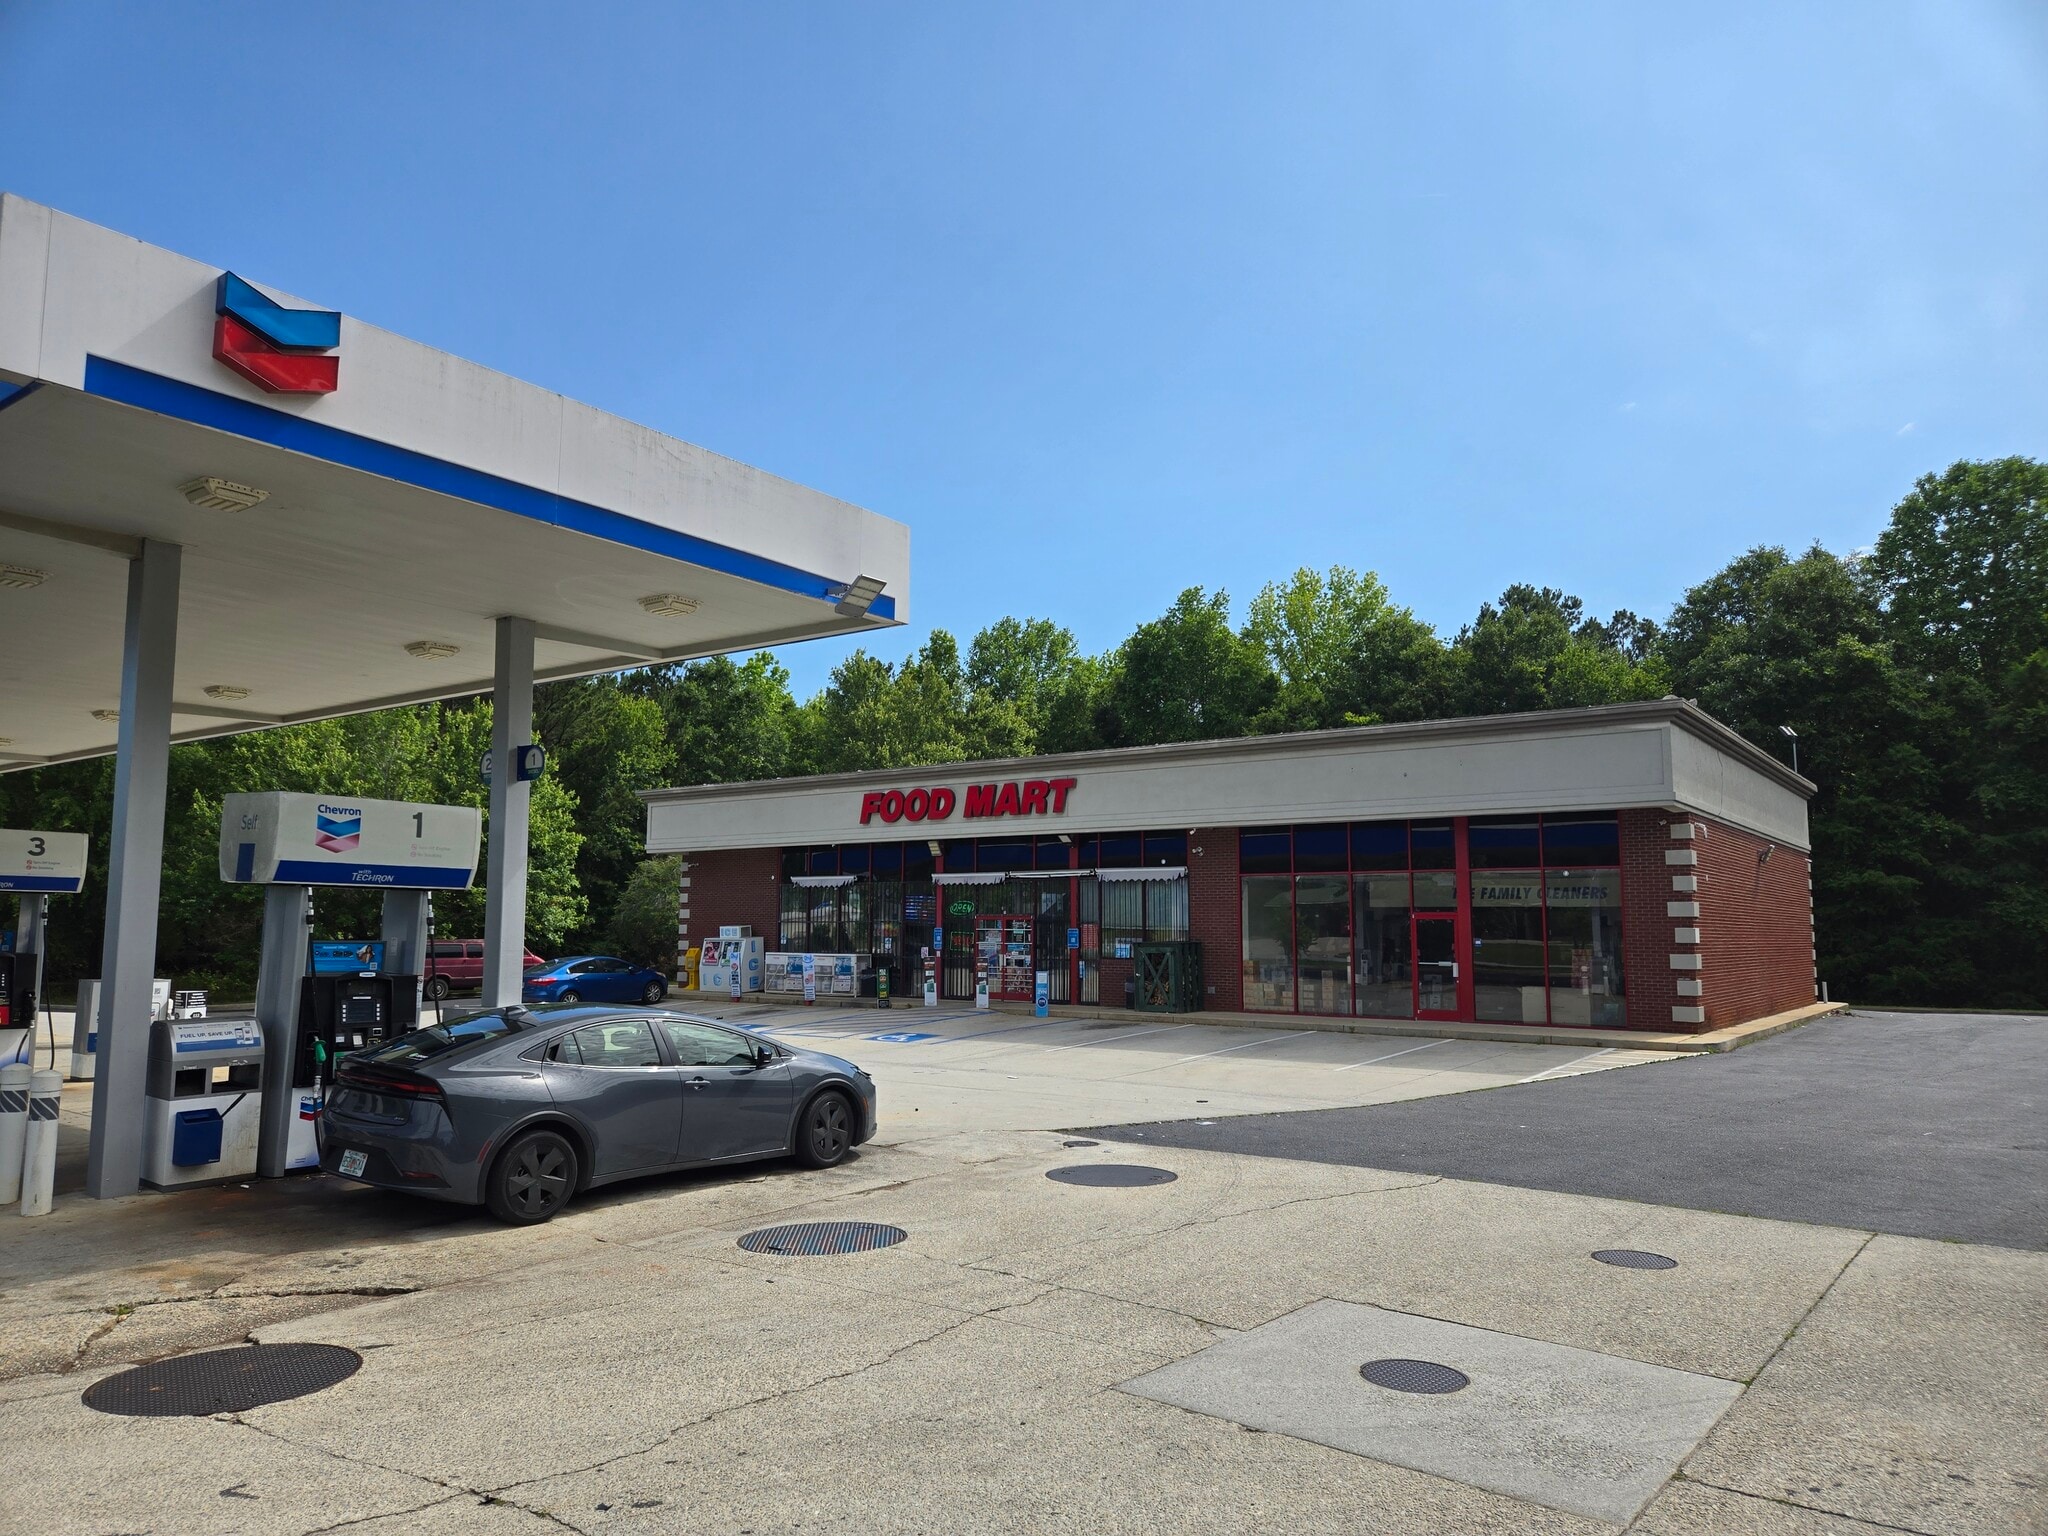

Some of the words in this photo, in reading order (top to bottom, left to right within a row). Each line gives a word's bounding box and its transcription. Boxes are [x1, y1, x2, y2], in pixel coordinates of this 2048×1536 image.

[531, 753, 536, 766] 1
[859, 787, 955, 825] FOOD
[963, 778, 1077, 818] MART
[317, 804, 362, 816] Chevron
[240, 814, 258, 830] Self
[412, 812, 423, 838] 1
[27, 837, 46, 856] 3
[351, 872, 394, 883] TECHRON
[1480, 887, 1532, 900] FAMILY
[952, 903, 972, 913] OPEN
[721, 928, 737, 936] ICE
[703, 973, 731, 986] IC
